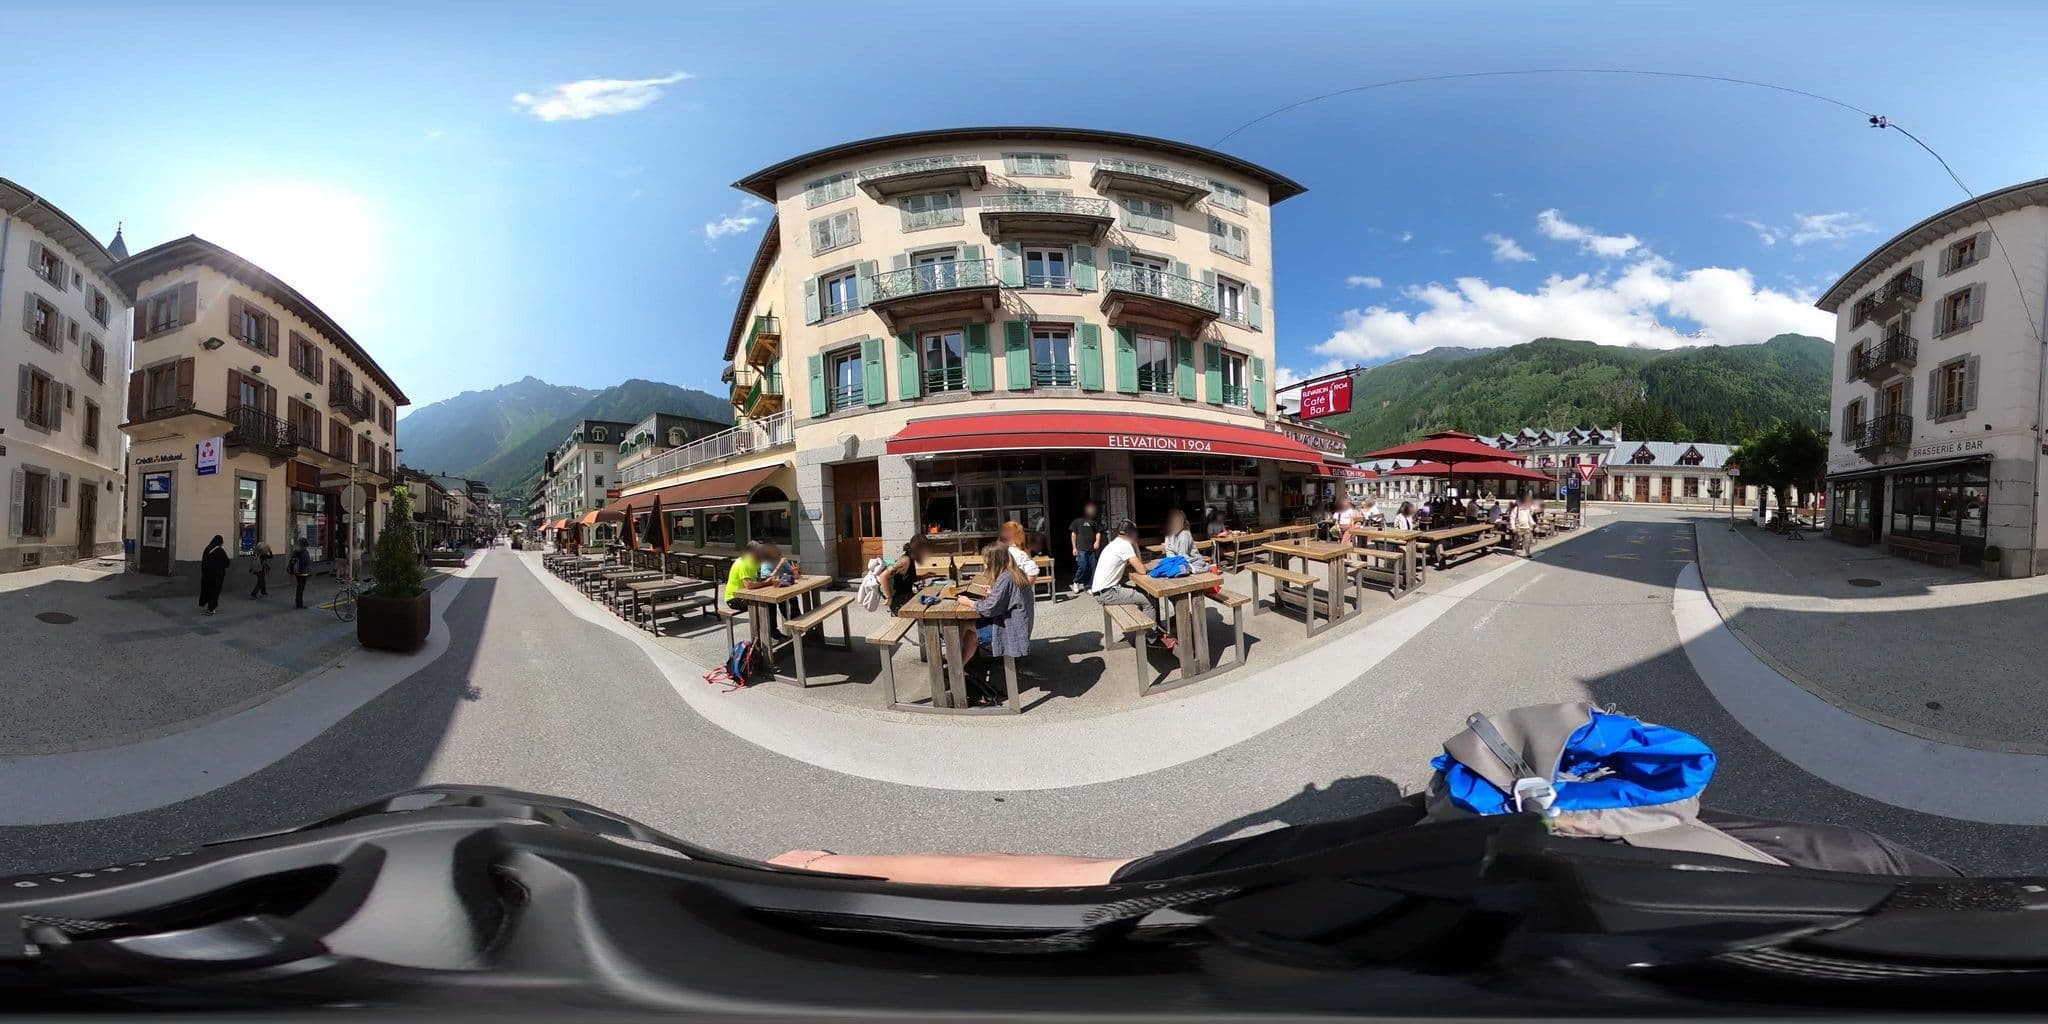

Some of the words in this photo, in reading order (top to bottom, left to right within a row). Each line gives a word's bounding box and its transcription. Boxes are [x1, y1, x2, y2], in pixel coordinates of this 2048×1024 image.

[1302, 386, 1329, 398] ELEVATION
[1304, 396, 1326, 407] Café
[1310, 406, 1326, 415] Bar
[1108, 435, 1178, 449] ELEVATION
[1182, 439, 1212, 451] 1904
[1913, 444, 1954, 457] BRASSERIE
[1957, 443, 1962, 451] &
[1965, 440, 1984, 450] BAR
[160, 452, 183, 462] Mutuel
